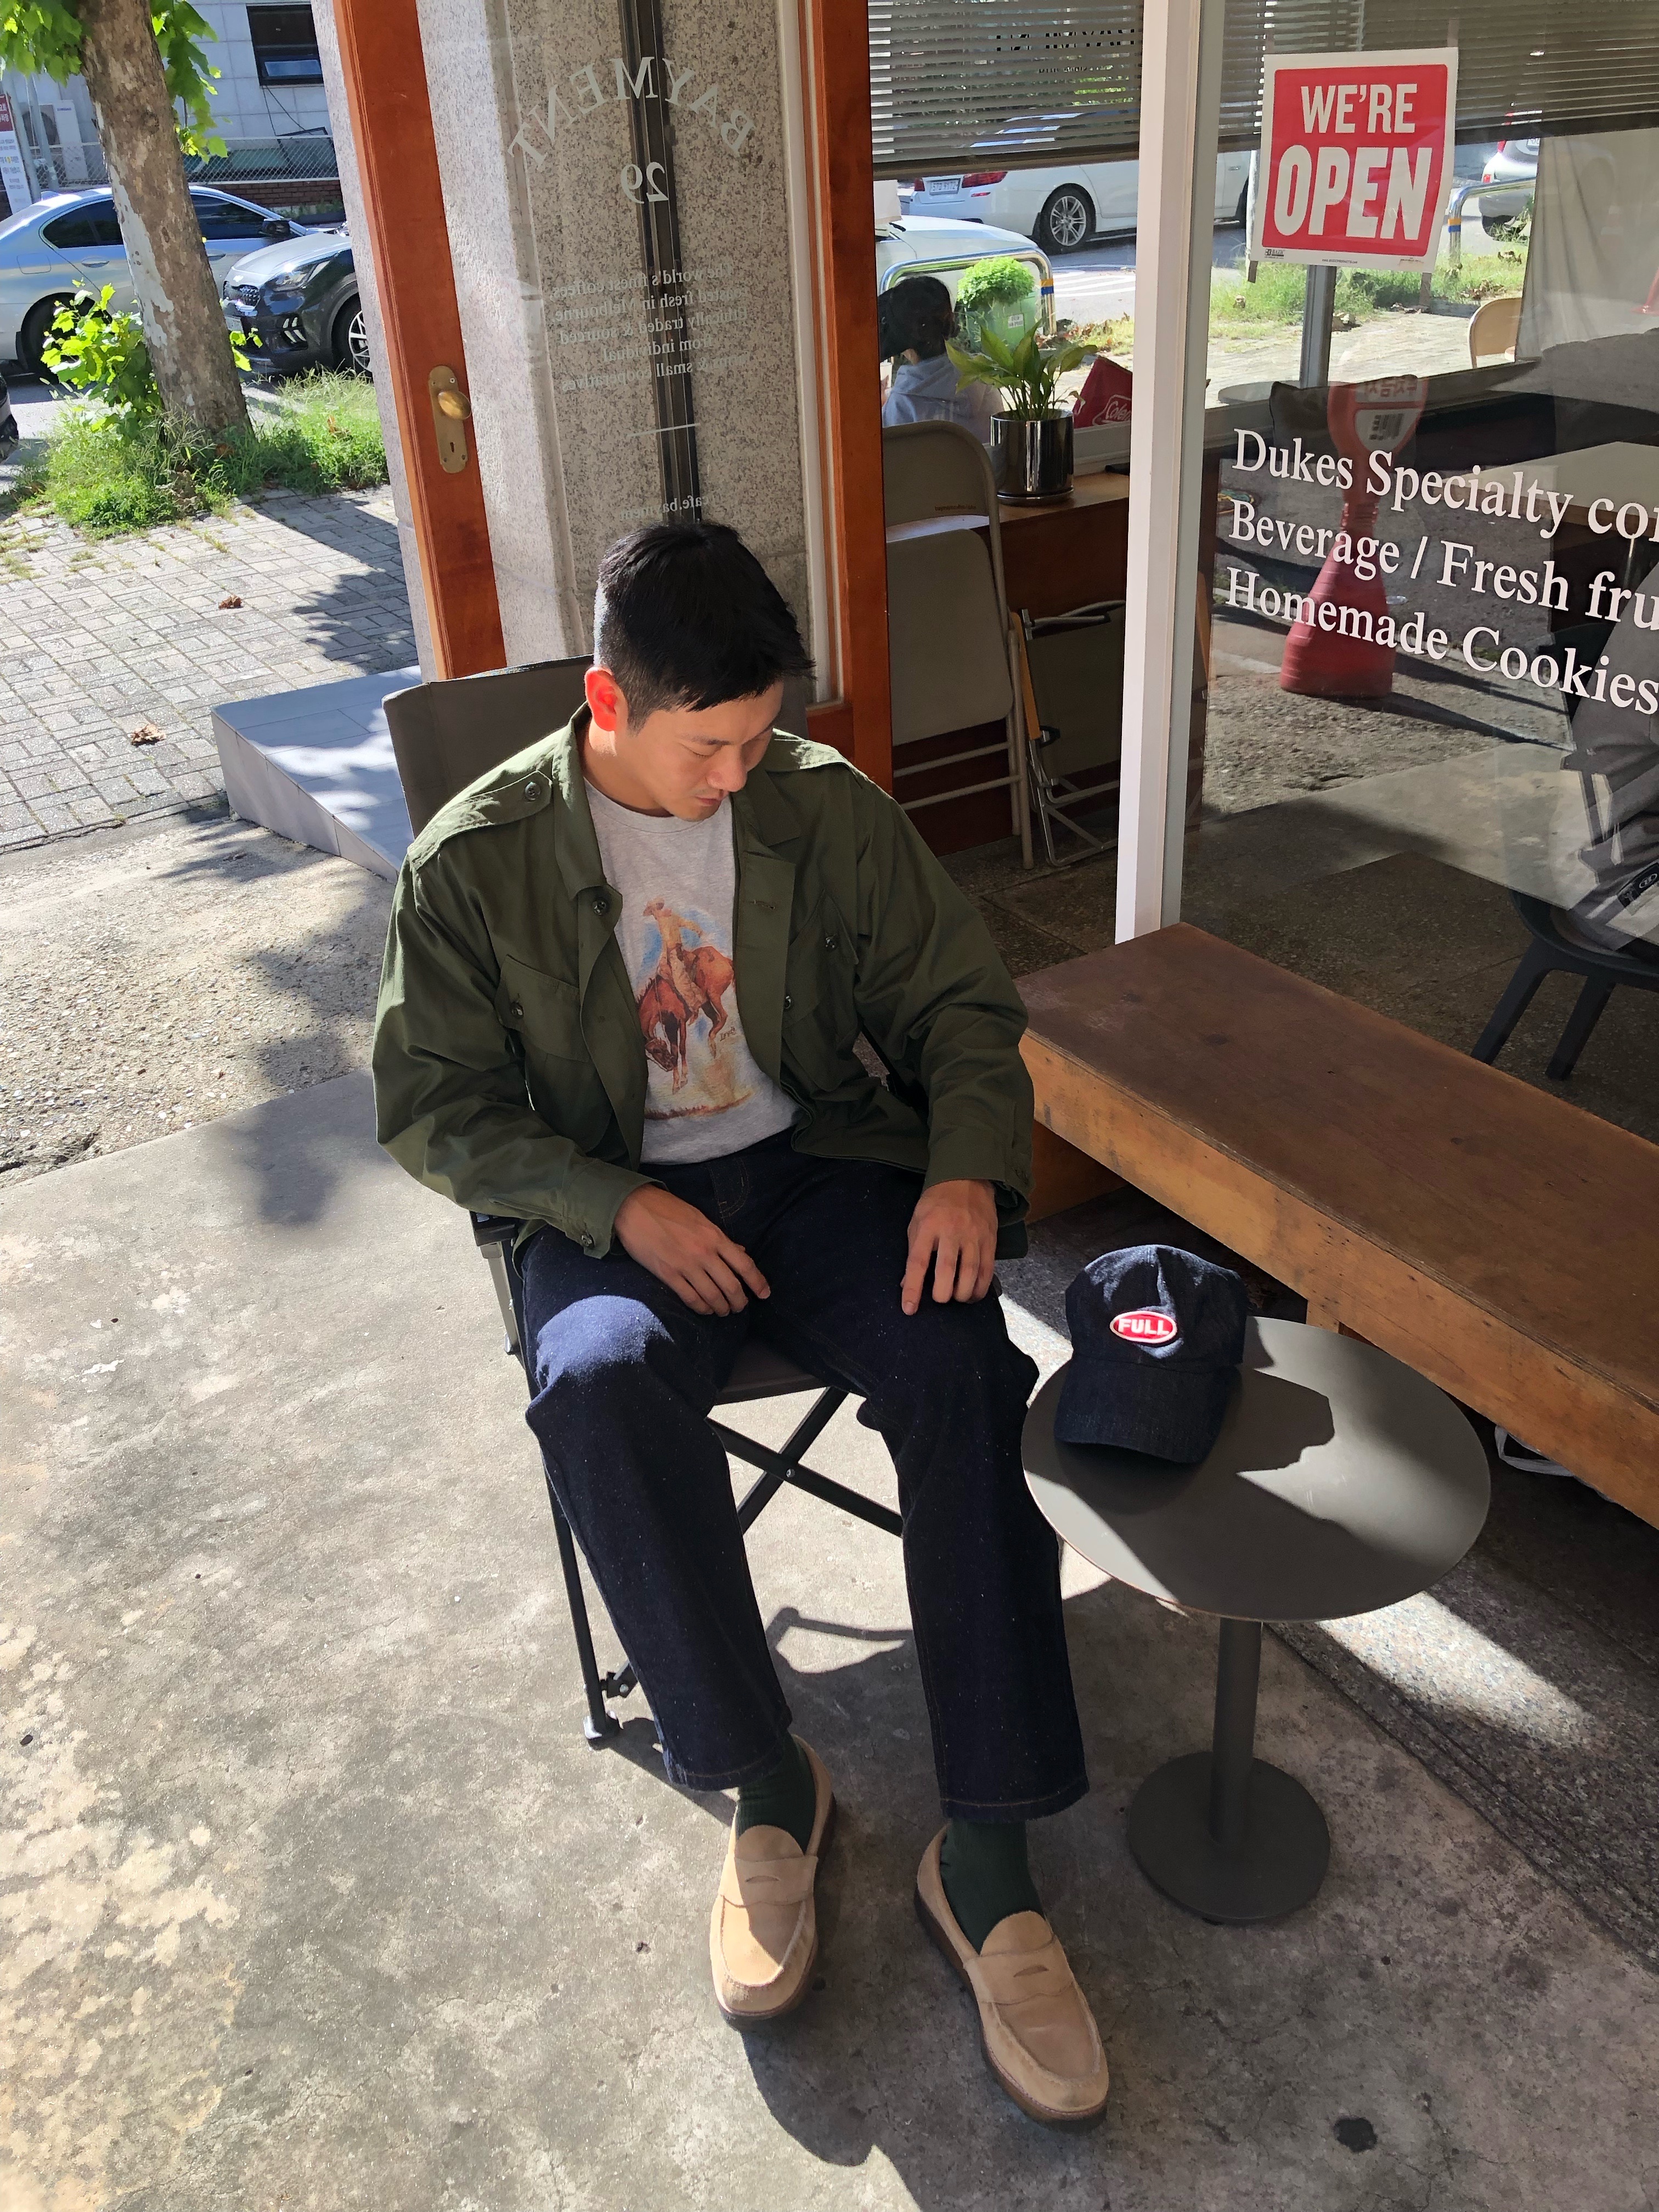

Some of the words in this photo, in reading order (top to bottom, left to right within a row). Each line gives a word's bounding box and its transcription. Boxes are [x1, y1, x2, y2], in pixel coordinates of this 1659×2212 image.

[1301, 83, 1418, 134] WE'RE
[1274, 144, 1432, 240] OPEN
[1232, 428, 1353, 490] Dukes
[1366, 450, 1573, 539] Specialty
[1228, 498, 1400, 582] Beverage
[1410, 536, 1428, 579] /
[1436, 540, 1570, 612] Fresh
[1225, 566, 1449, 660] Homemade
[1463, 627, 1659, 715] Cookies
[1118, 1318, 1170, 1335] FULL
